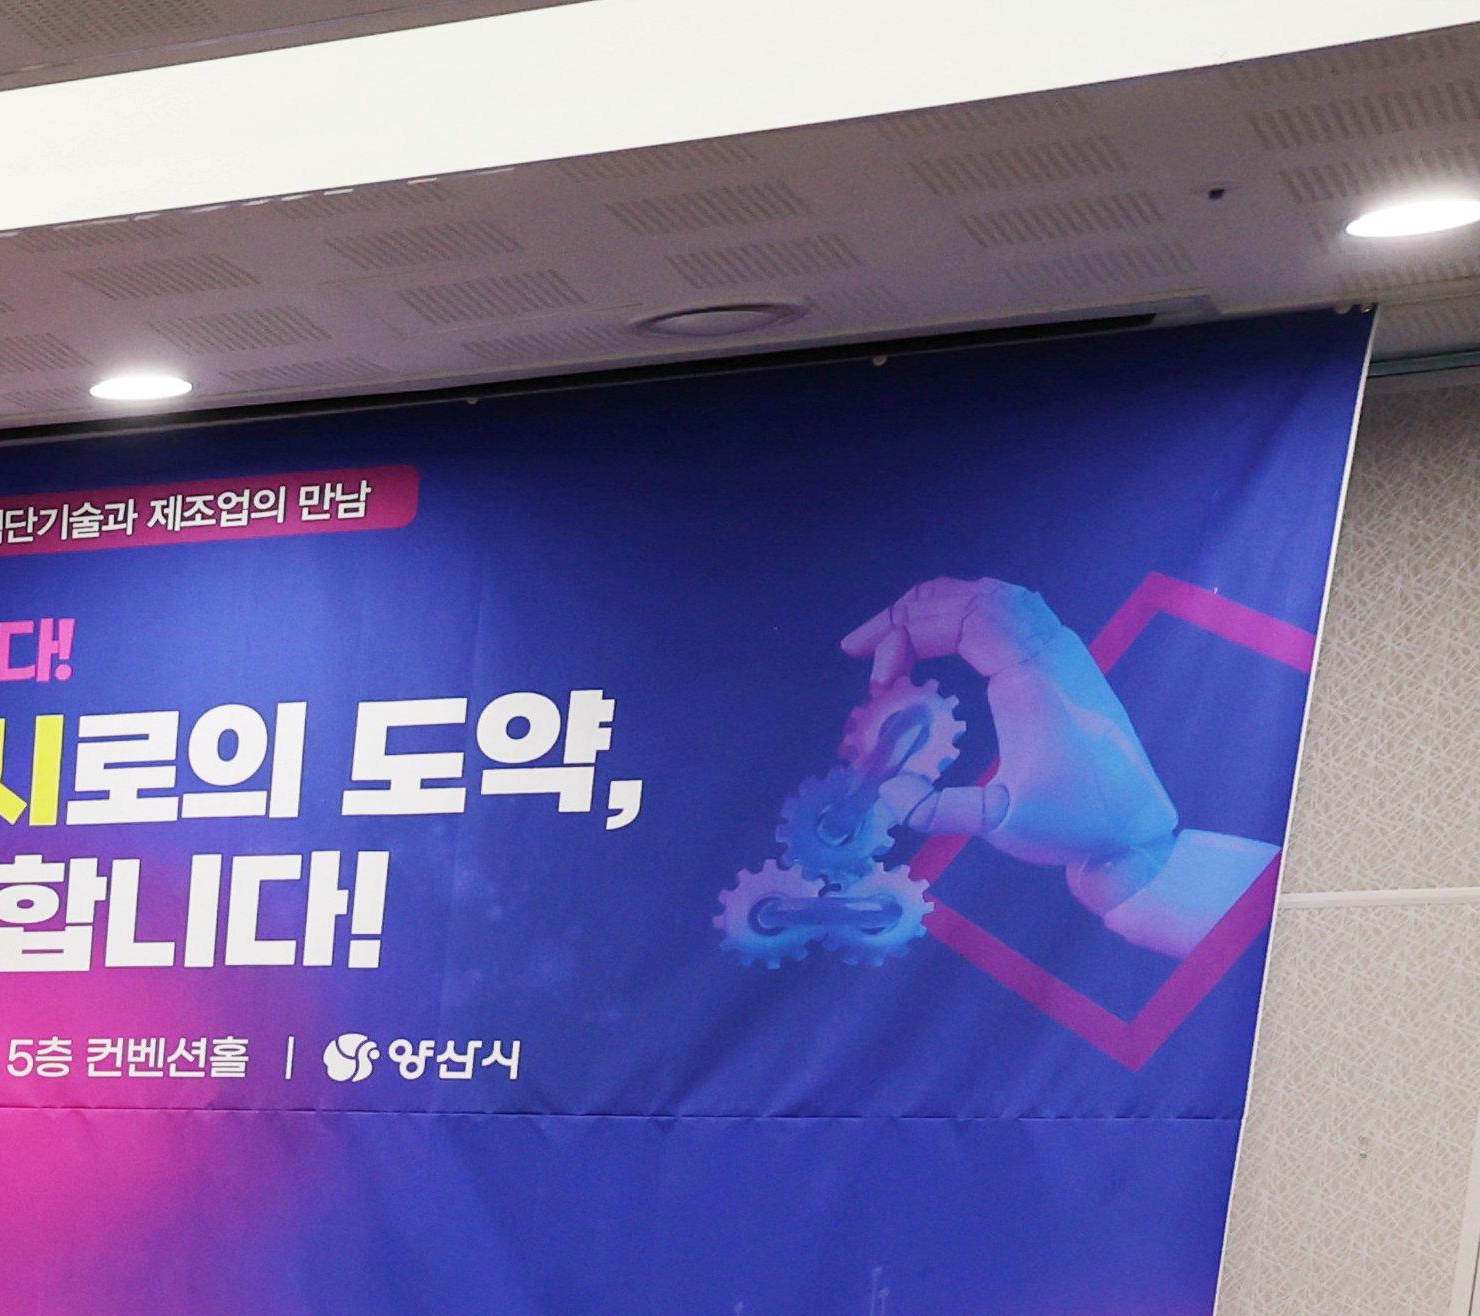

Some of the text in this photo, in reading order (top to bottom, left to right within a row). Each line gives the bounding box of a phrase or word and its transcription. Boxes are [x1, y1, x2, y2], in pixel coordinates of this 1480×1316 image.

[147, 485, 286, 532] 제조업의
[298, 480, 372, 521] 만남
[341, 689, 643, 830] 도약,
[7, 1036, 73, 1078] 5층
[86, 1035, 249, 1078] 컨벤션홀
[388, 1038, 521, 1080] 양산시
